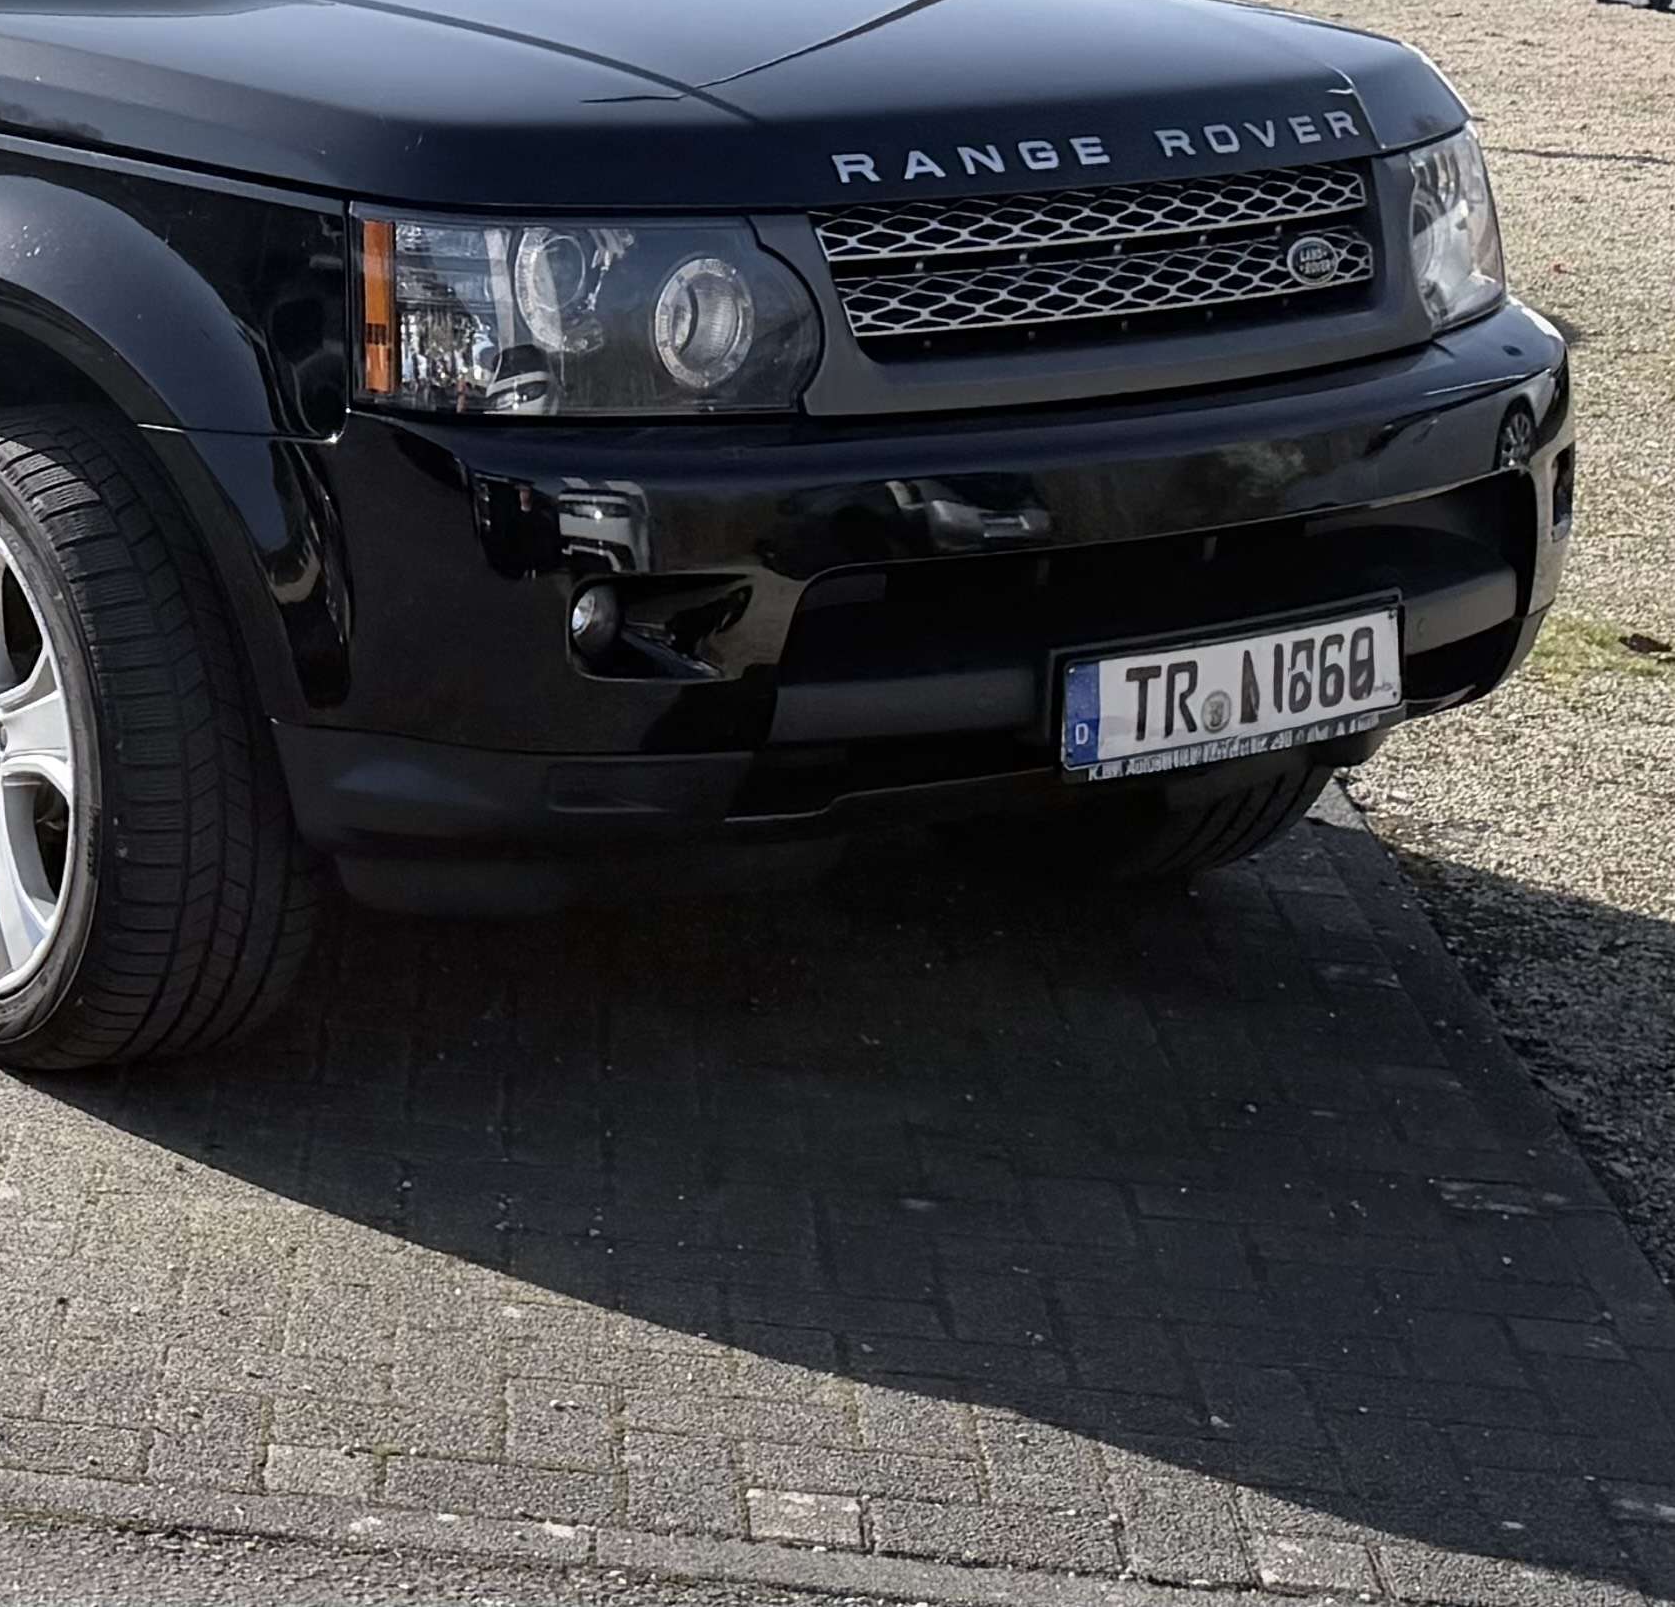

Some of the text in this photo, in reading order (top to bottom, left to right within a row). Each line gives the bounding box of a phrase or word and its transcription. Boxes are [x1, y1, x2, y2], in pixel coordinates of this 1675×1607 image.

[831, 109, 1360, 184] RANGE ROVER
[1075, 722, 1090, 745] D
[1126, 659, 1199, 742] TR
